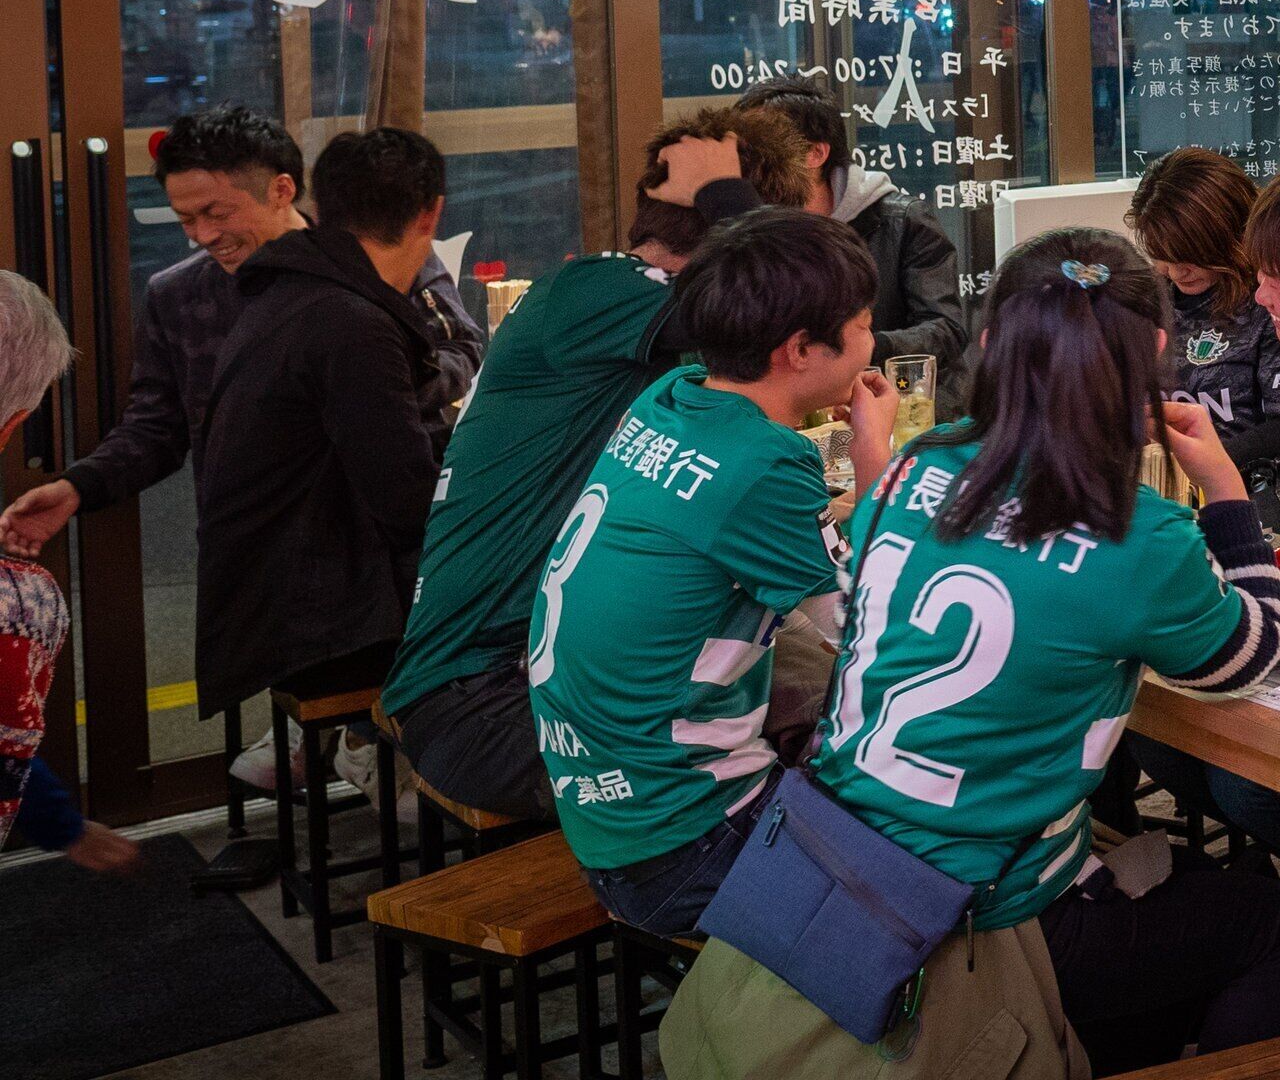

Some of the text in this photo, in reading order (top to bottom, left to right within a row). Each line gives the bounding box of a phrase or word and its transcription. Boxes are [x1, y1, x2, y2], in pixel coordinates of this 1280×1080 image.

[605, 417, 720, 501] 長野銀行
[828, 531, 1016, 808] 12
